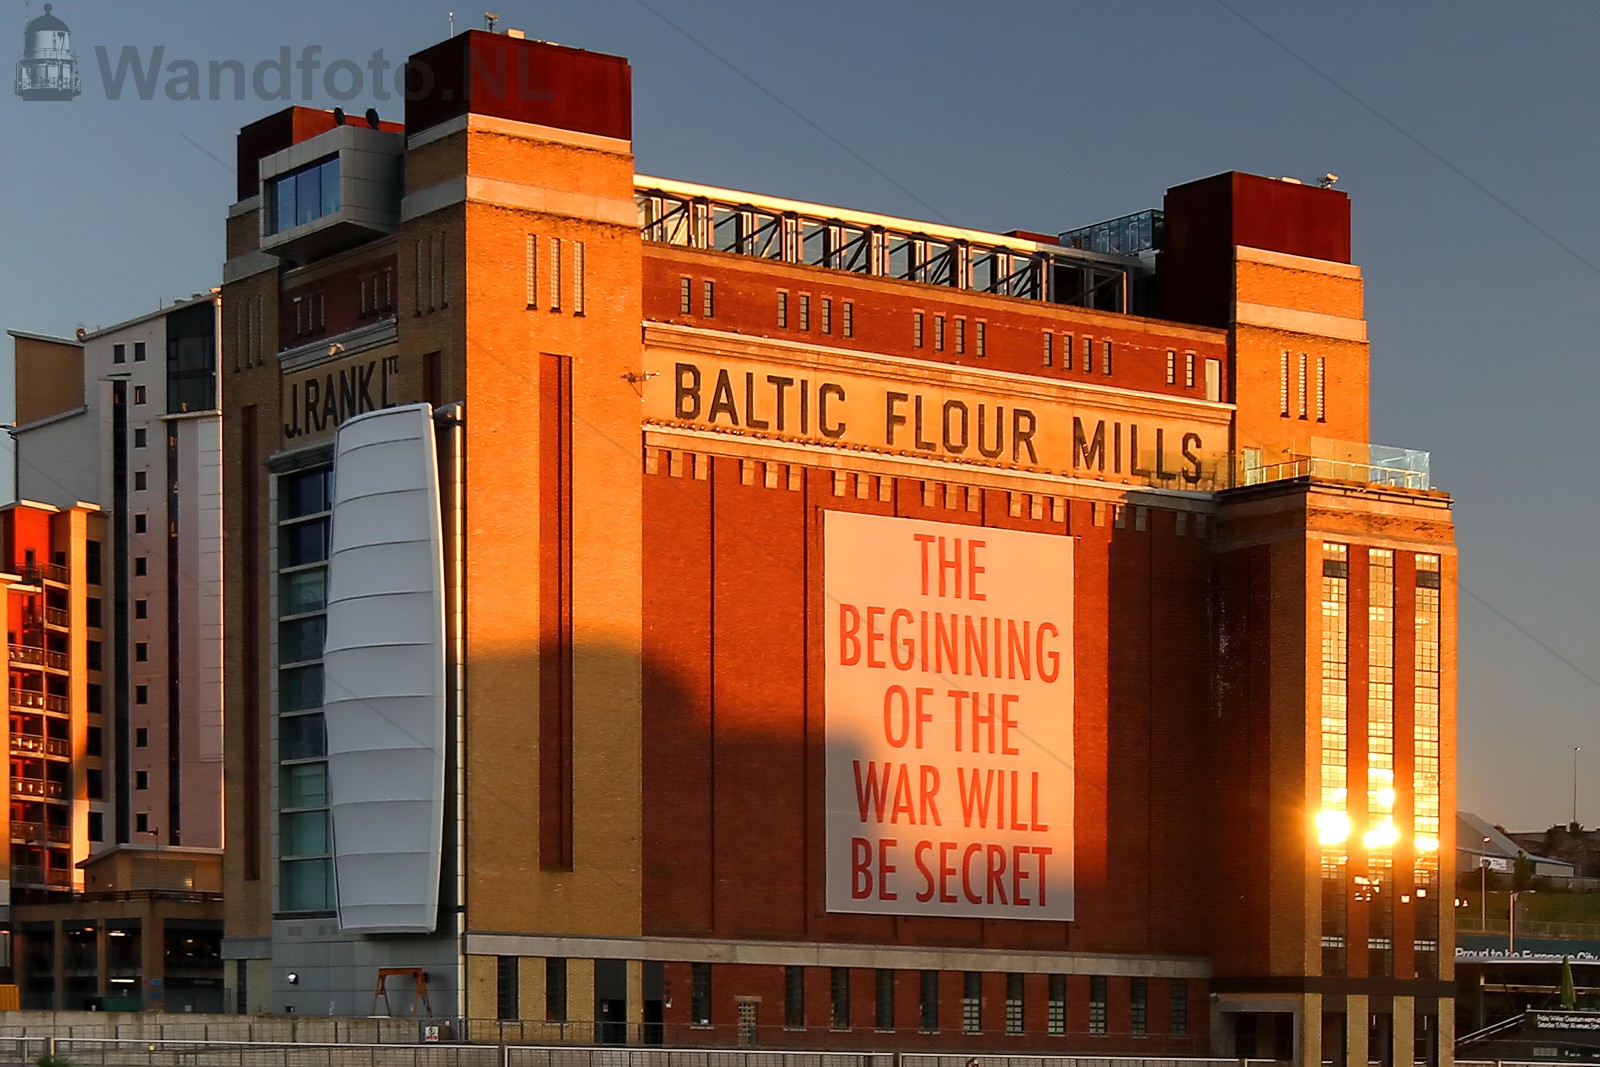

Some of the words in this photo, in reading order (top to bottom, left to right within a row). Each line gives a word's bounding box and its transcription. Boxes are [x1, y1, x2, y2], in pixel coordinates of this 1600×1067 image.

[675, 362, 847, 439] BALTIC
[886, 391, 1038, 465] FLOUR
[1072, 416, 1202, 484] MILLS
[913, 533, 986, 601] THE
[839, 603, 1060, 683] BEGINNING
[883, 684, 934, 749] OF
[947, 689, 1019, 755] THE
[852, 759, 942, 827] WAR
[957, 767, 1048, 832] WILL
[851, 836, 898, 901] BE
[914, 840, 1053, 907] SECRET
[1522, 950, 1575, 960] Europen
